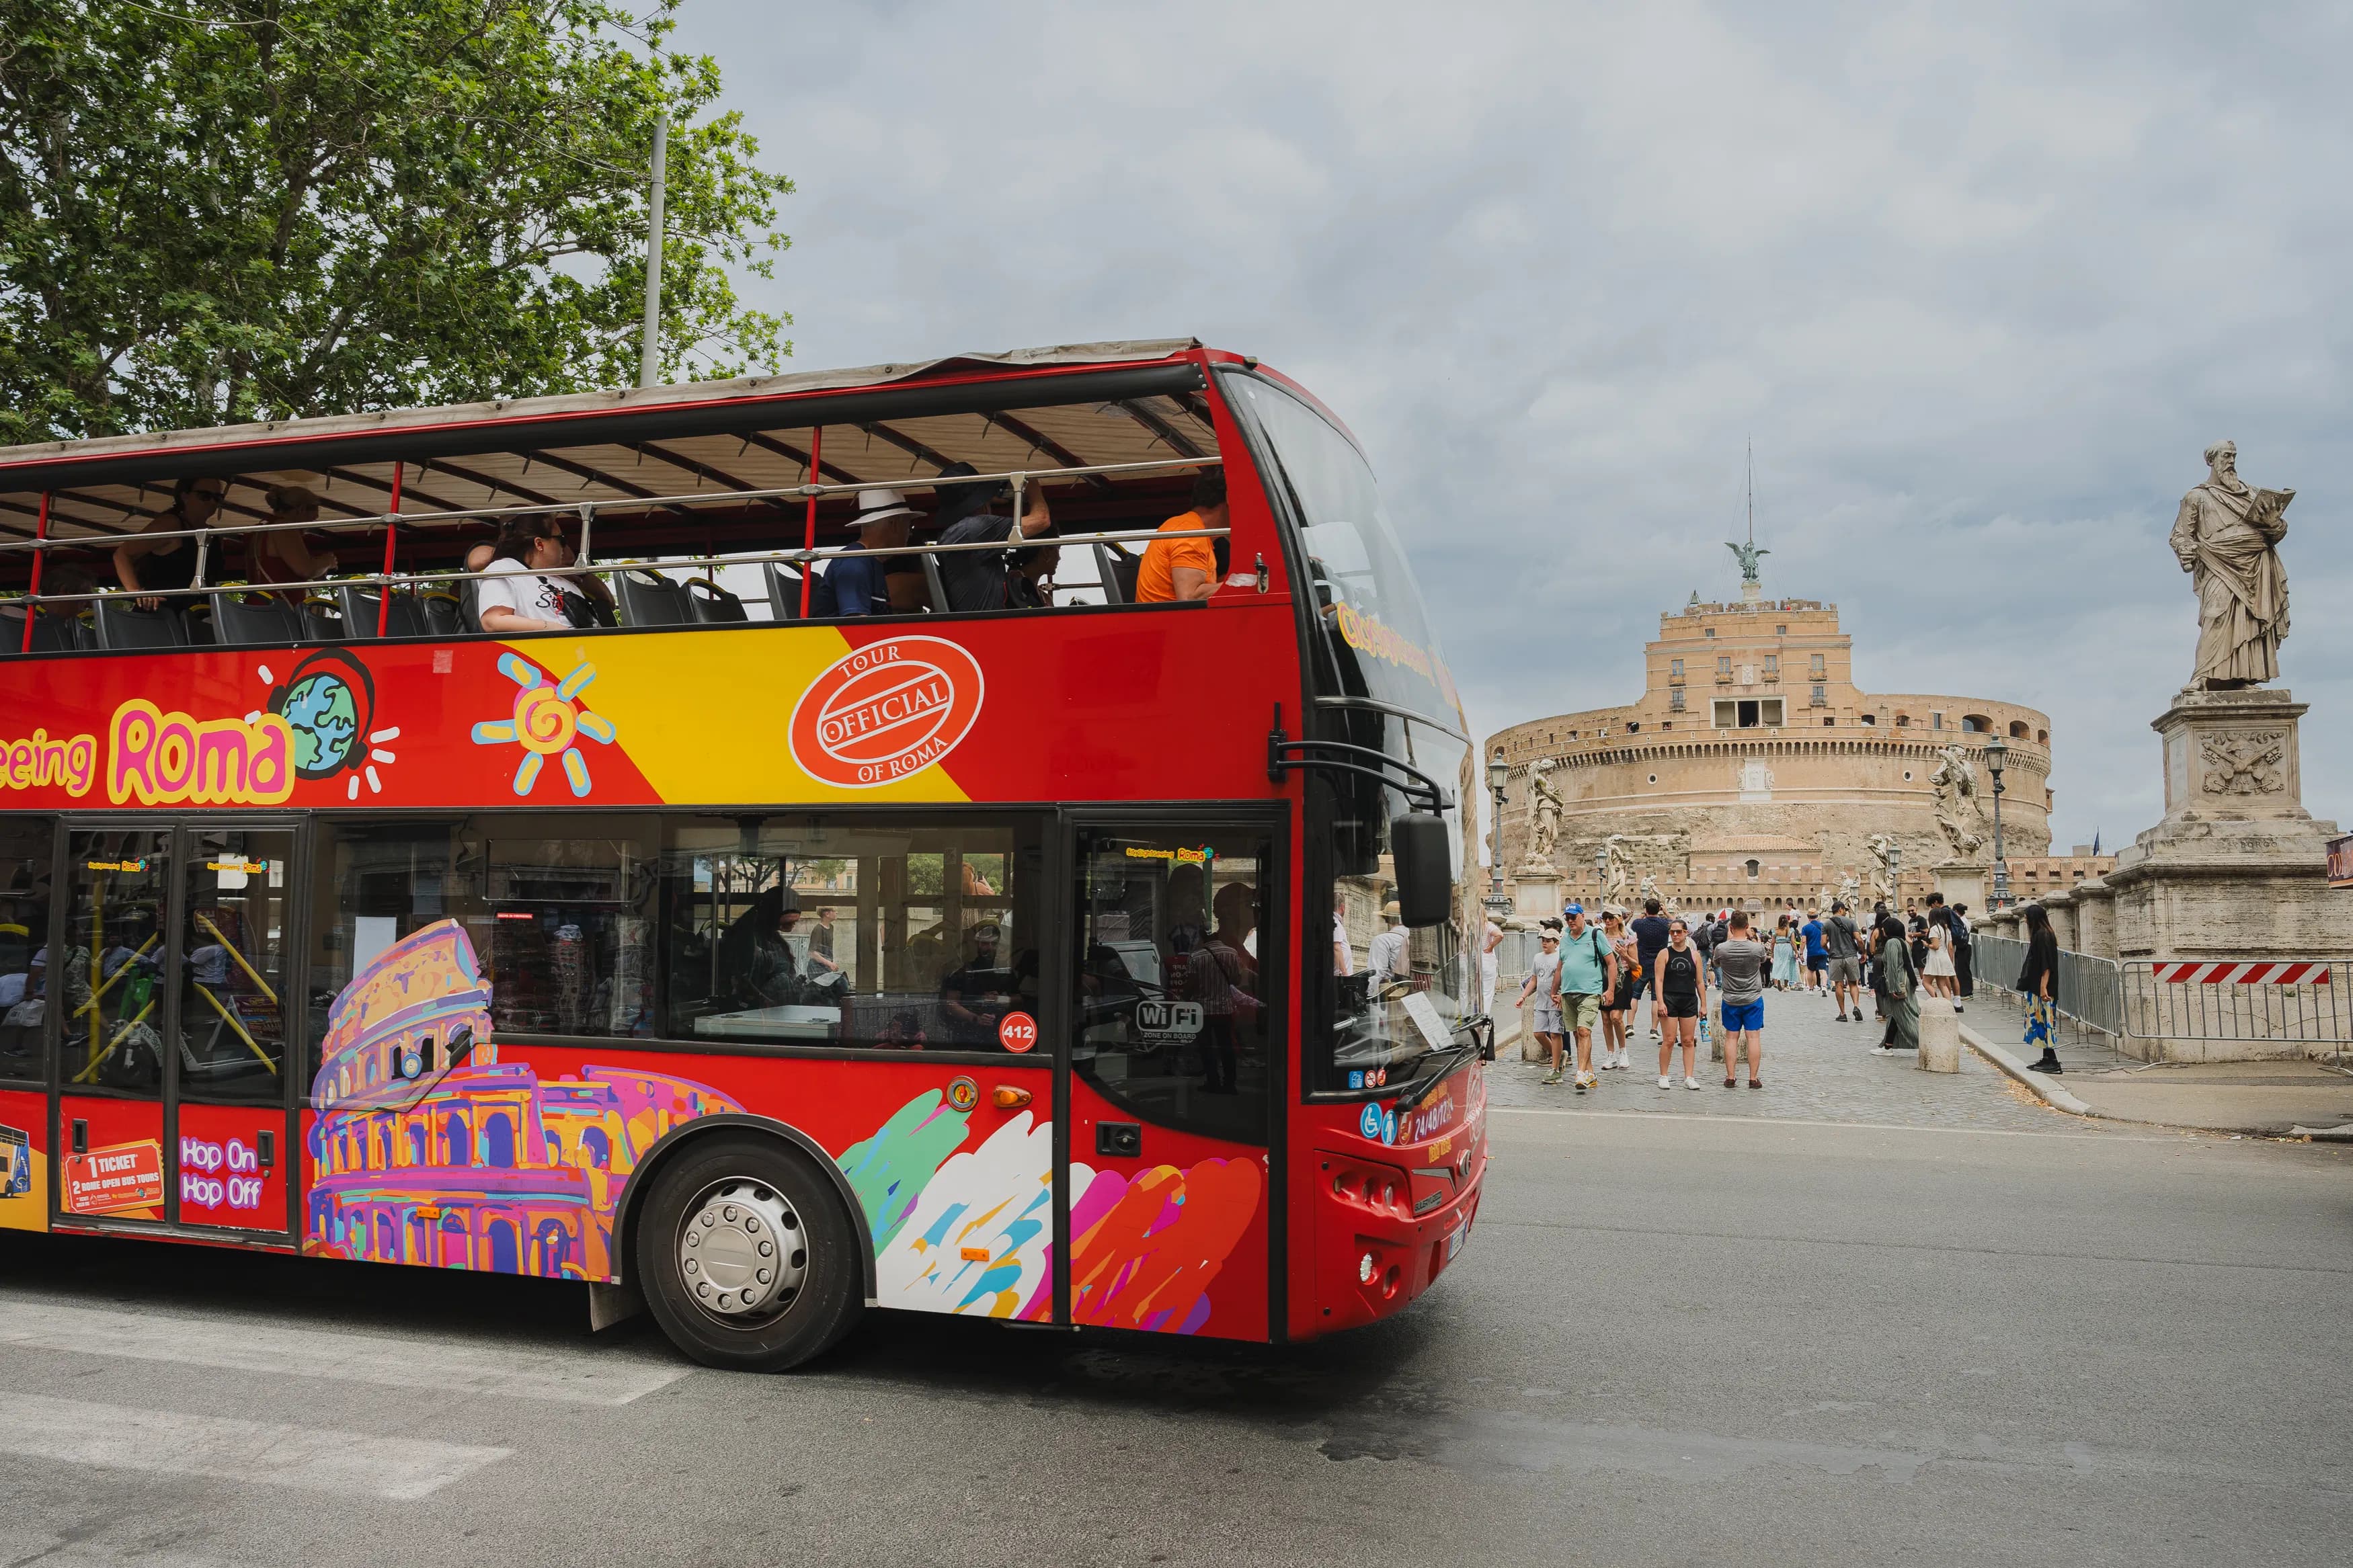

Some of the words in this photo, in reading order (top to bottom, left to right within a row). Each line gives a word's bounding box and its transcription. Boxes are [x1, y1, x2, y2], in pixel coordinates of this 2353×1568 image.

[838, 646, 902, 678] TOUR
[822, 682, 947, 743] OFFICIAL
[110, 703, 291, 800] Roma
[858, 765, 883, 782] OF
[889, 737, 948, 777] ROMA
[122, 860, 141, 872] Roma
[243, 862, 262, 873] Roma
[1178, 848, 1205, 862] Roma
[1004, 1026, 1033, 1038] 412
[87, 1157, 97, 1178] 1
[182, 1139, 223, 1170] Hop
[227, 1141, 255, 1171] On
[73, 1181, 81, 1194] 2
[81, 1181, 101, 1192] ROME
[102, 1178, 120, 1188] OPEN
[122, 1175, 136, 1186] BUS
[136, 1172, 159, 1184] TOURS
[183, 1176, 223, 1205] Hop
[228, 1178, 262, 1205] Off
